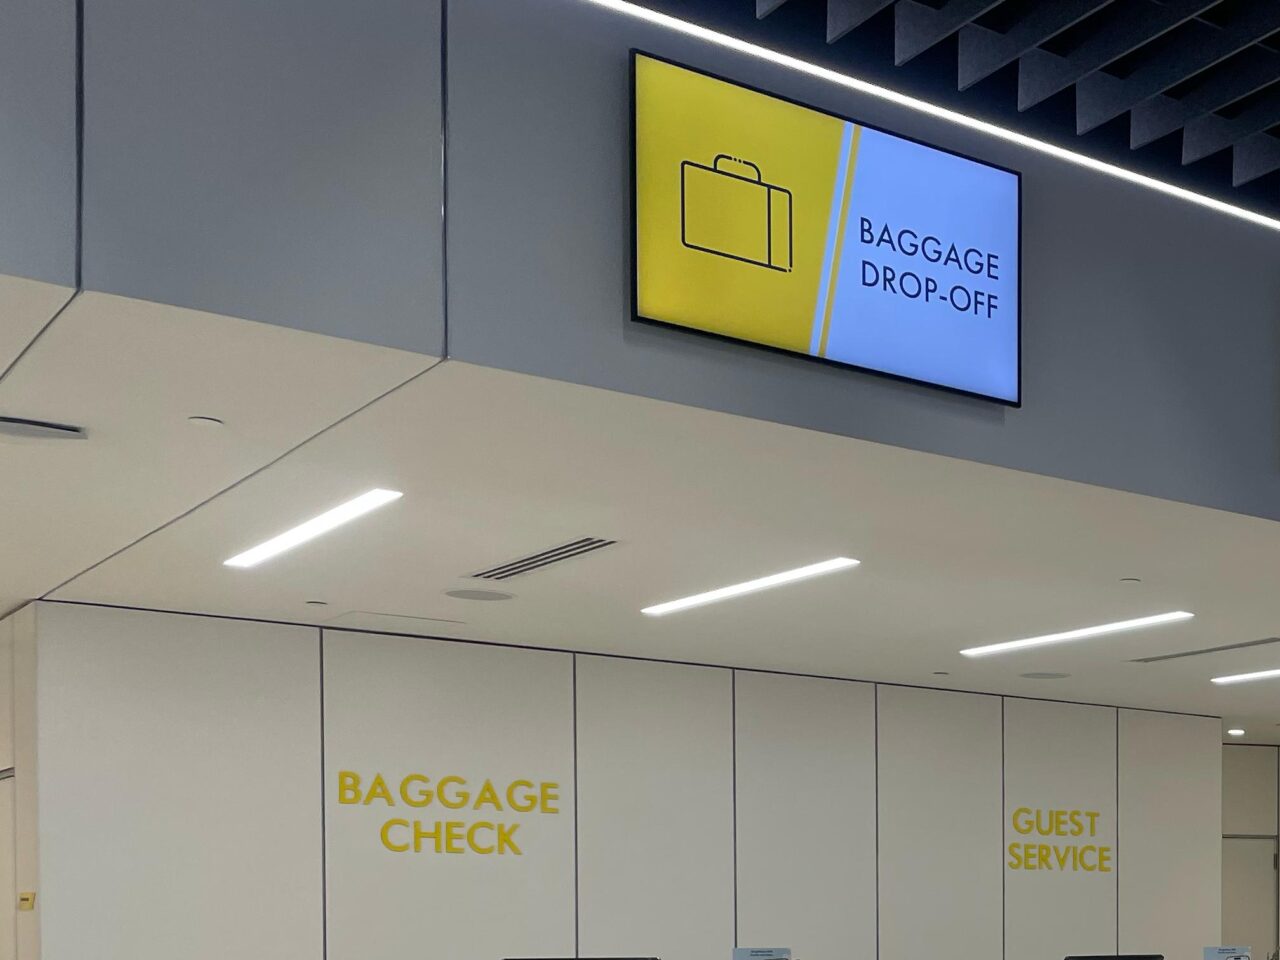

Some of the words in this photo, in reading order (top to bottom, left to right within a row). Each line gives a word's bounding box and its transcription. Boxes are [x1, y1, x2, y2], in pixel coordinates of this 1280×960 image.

[860, 217, 999, 280] BAGGAGE
[861, 260, 999, 319] DROP-OFF
[338, 770, 560, 814] BAGGAGE
[380, 818, 523, 856] CHECK
[1012, 806, 1100, 837] GUEST
[1007, 842, 1112, 872] SERVICE
